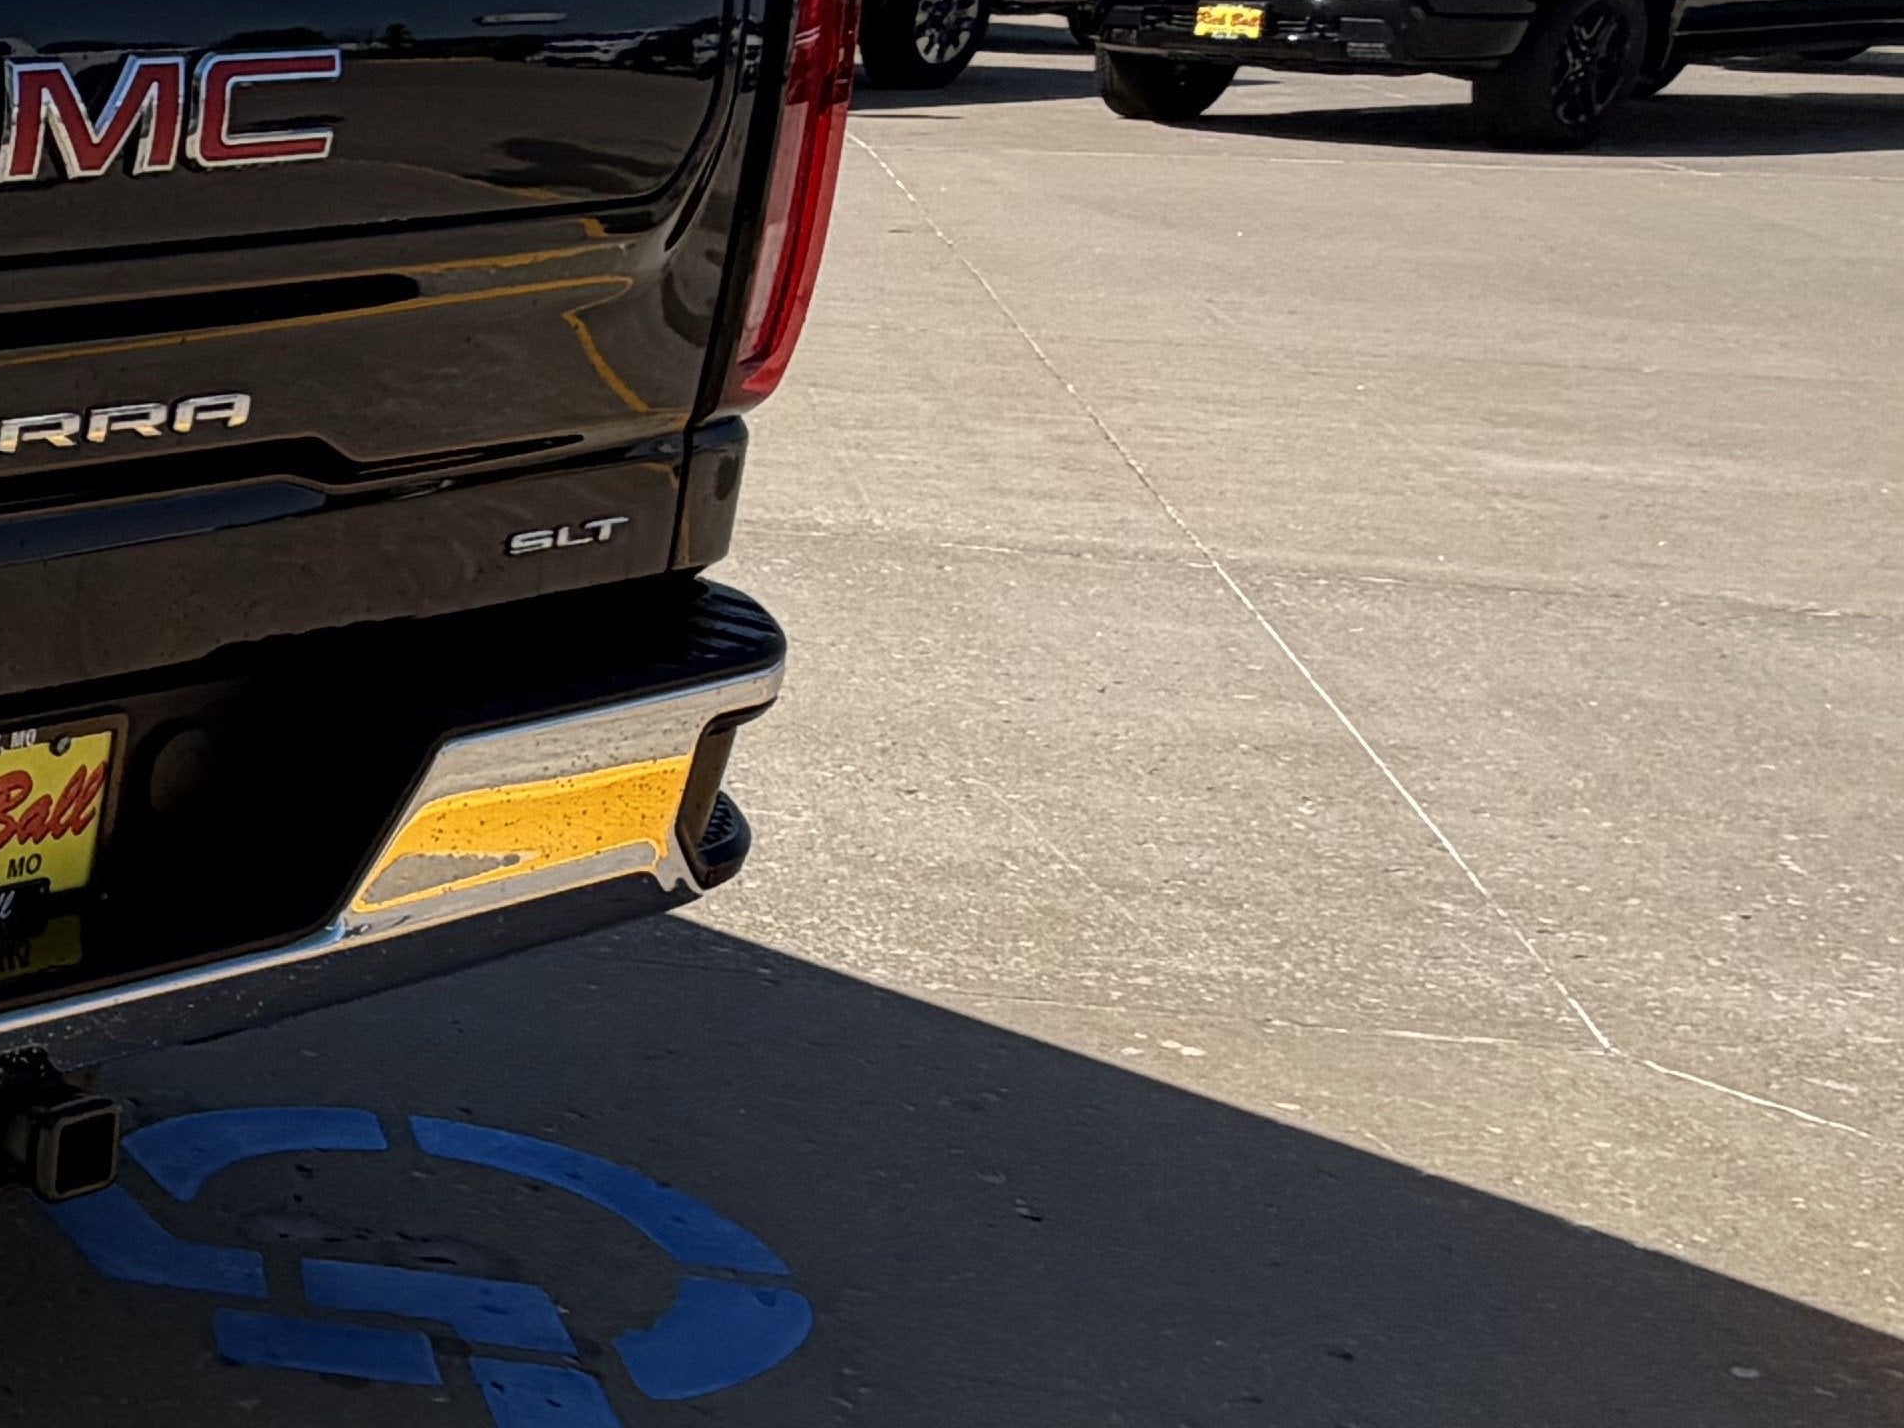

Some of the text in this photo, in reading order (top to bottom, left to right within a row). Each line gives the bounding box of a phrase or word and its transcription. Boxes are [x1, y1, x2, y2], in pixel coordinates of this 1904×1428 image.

[506, 515, 629, 557] SLT
[10, 728, 38, 750] MO
[6, 853, 42, 880] MO
